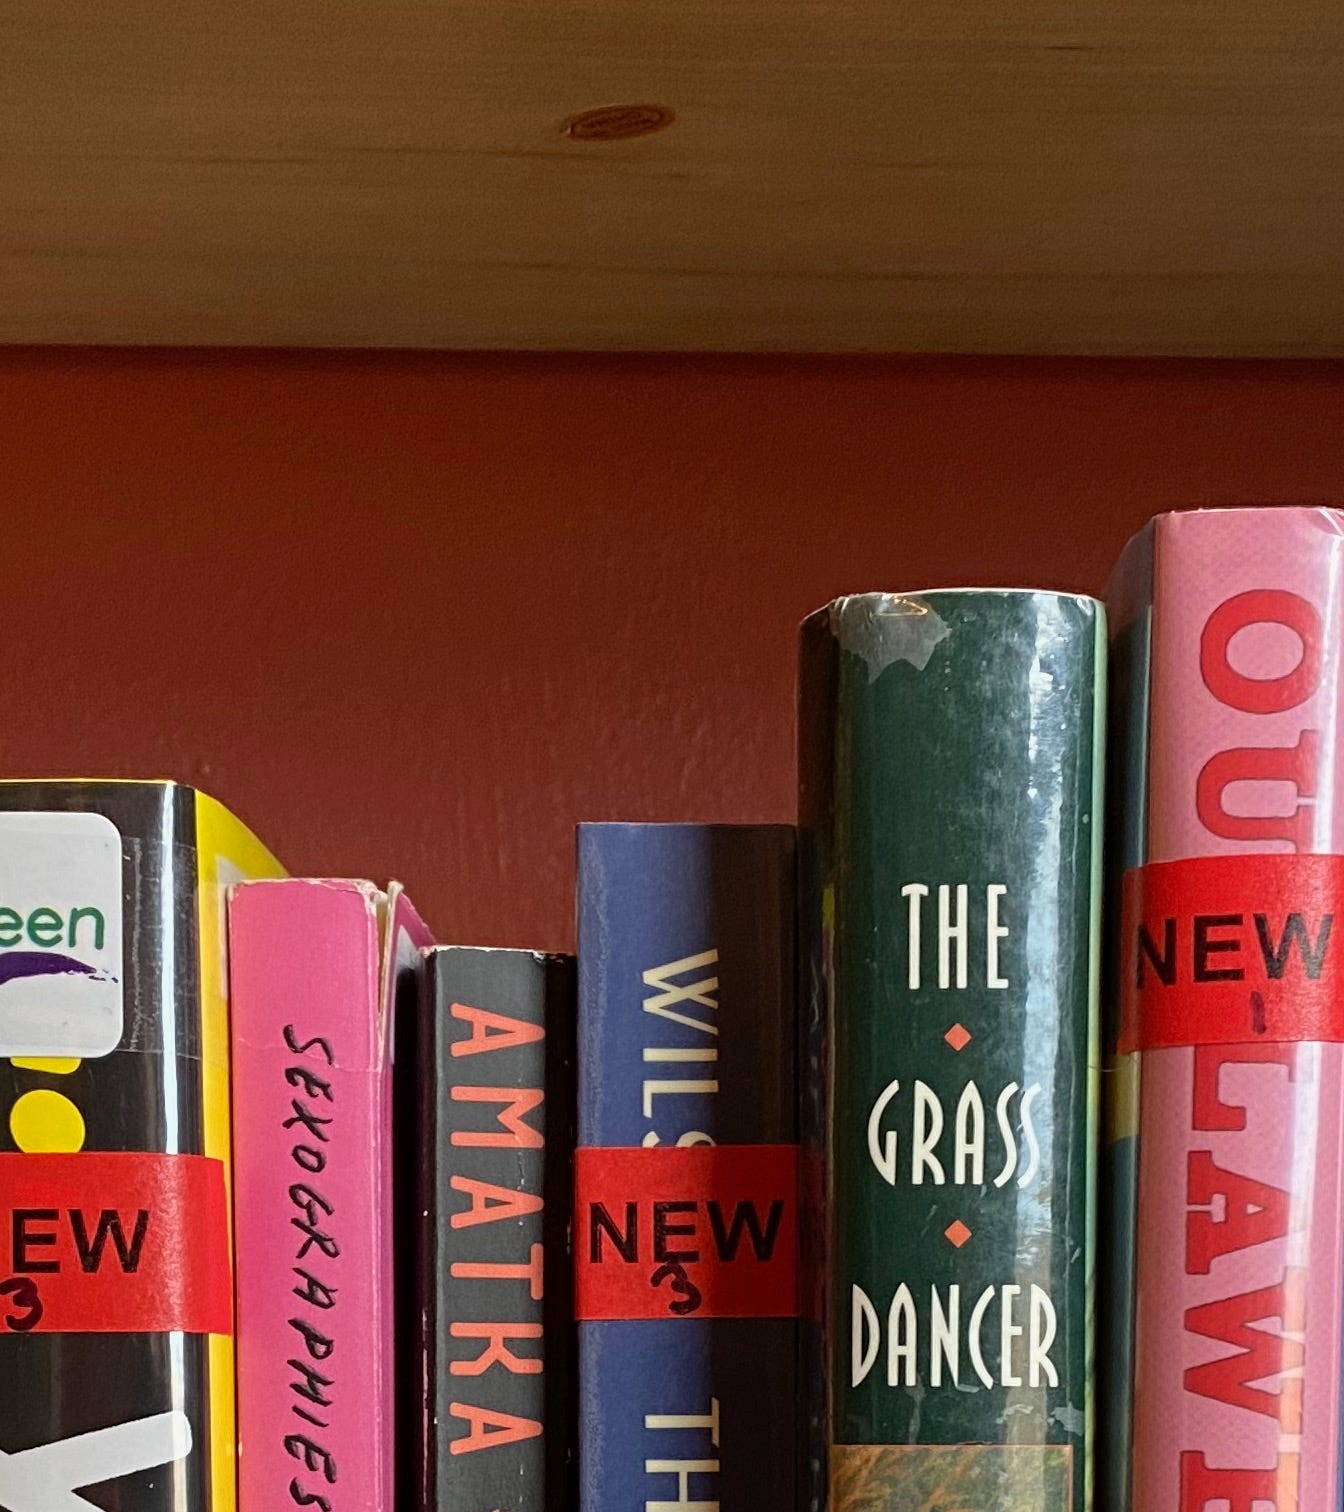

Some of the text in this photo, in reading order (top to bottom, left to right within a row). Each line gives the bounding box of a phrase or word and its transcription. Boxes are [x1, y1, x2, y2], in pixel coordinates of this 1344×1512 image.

[901, 883, 1009, 990] THE
[1136, 913, 1333, 989] NEW
[867, 1079, 1042, 1189] GRASS
[282, 1024, 340, 1512] SEXOGRAPHIES
[450, 1002, 546, 1456] AMATKA
[589, 1200, 784, 1264] NEW
[650, 1261, 702, 1316] 3
[851, 1281, 1059, 1390] DANCER
